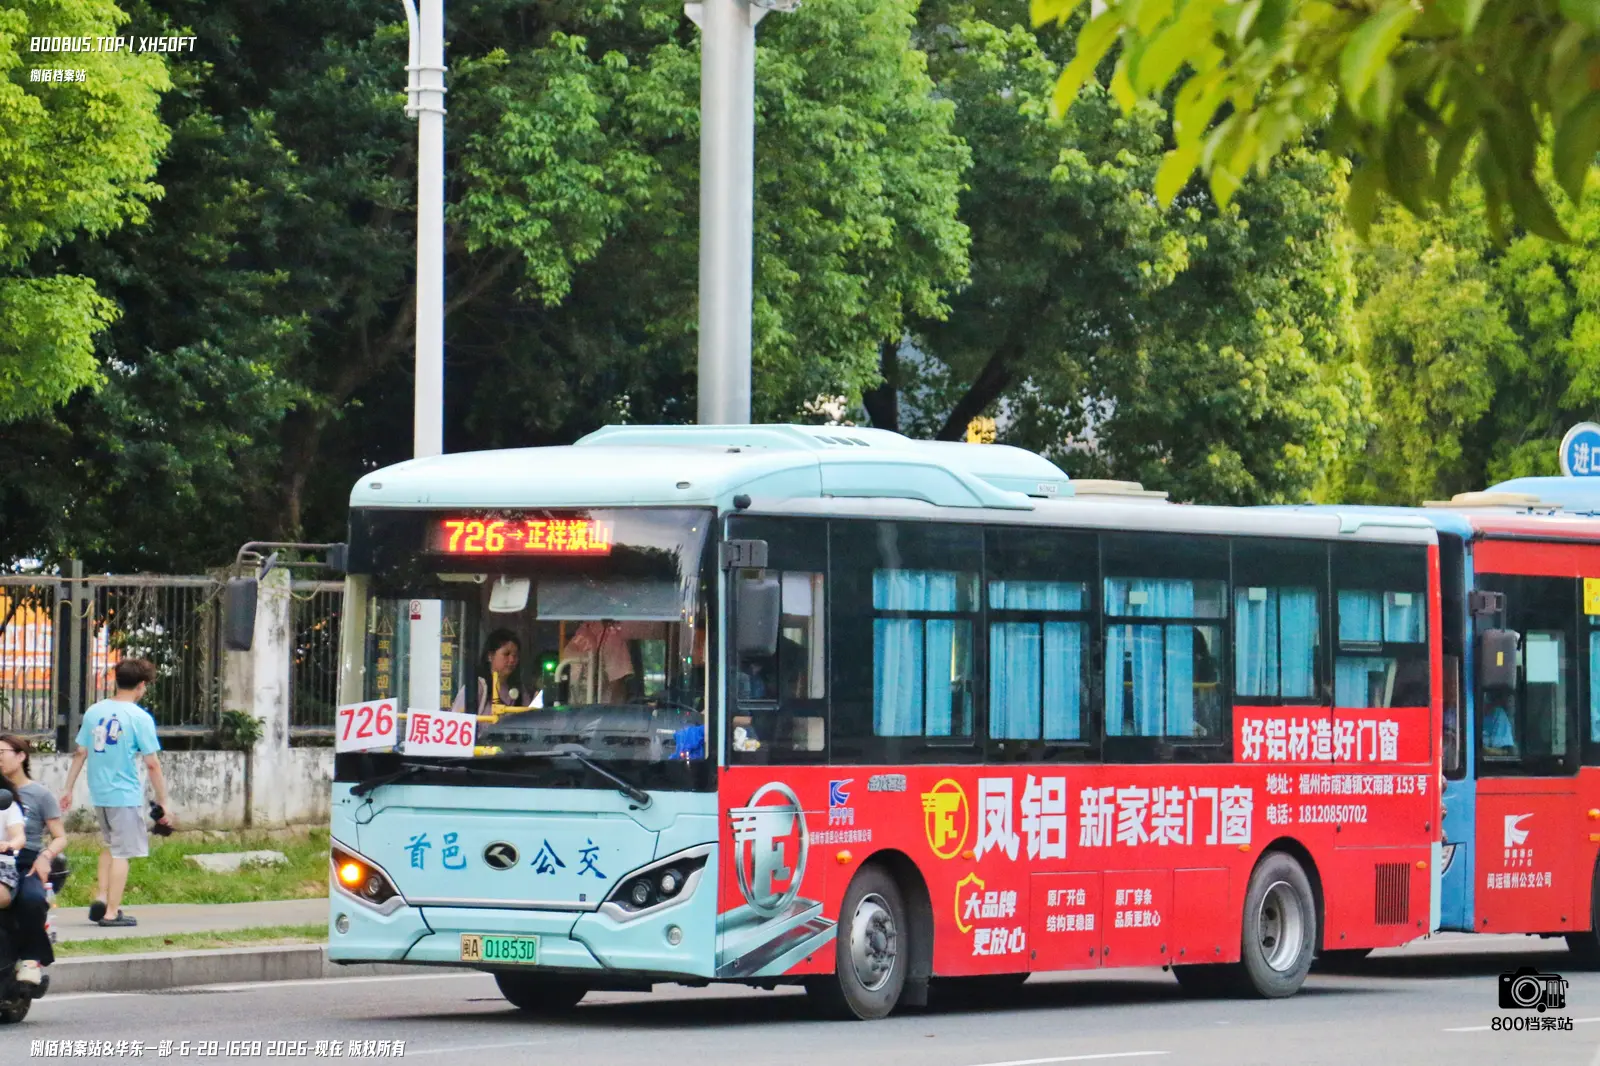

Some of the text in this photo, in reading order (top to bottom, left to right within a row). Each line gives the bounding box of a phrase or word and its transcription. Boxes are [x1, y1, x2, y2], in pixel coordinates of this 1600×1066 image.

[445, 520, 609, 552] 726 正祥旗山
[340, 703, 393, 741] 726
[408, 713, 473, 747] 原326
[1241, 718, 1400, 761] 好铝材造好门窗
[974, 774, 1253, 862] 凤铝 新家装门窗
[1299, 804, 1368, 823] 18120850702
[404, 832, 608, 880] 首邑 公交
[963, 891, 1017, 920] 大品牌
[1115, 911, 1161, 928] 品质更放心
[972, 927, 1026, 956] 更放心
